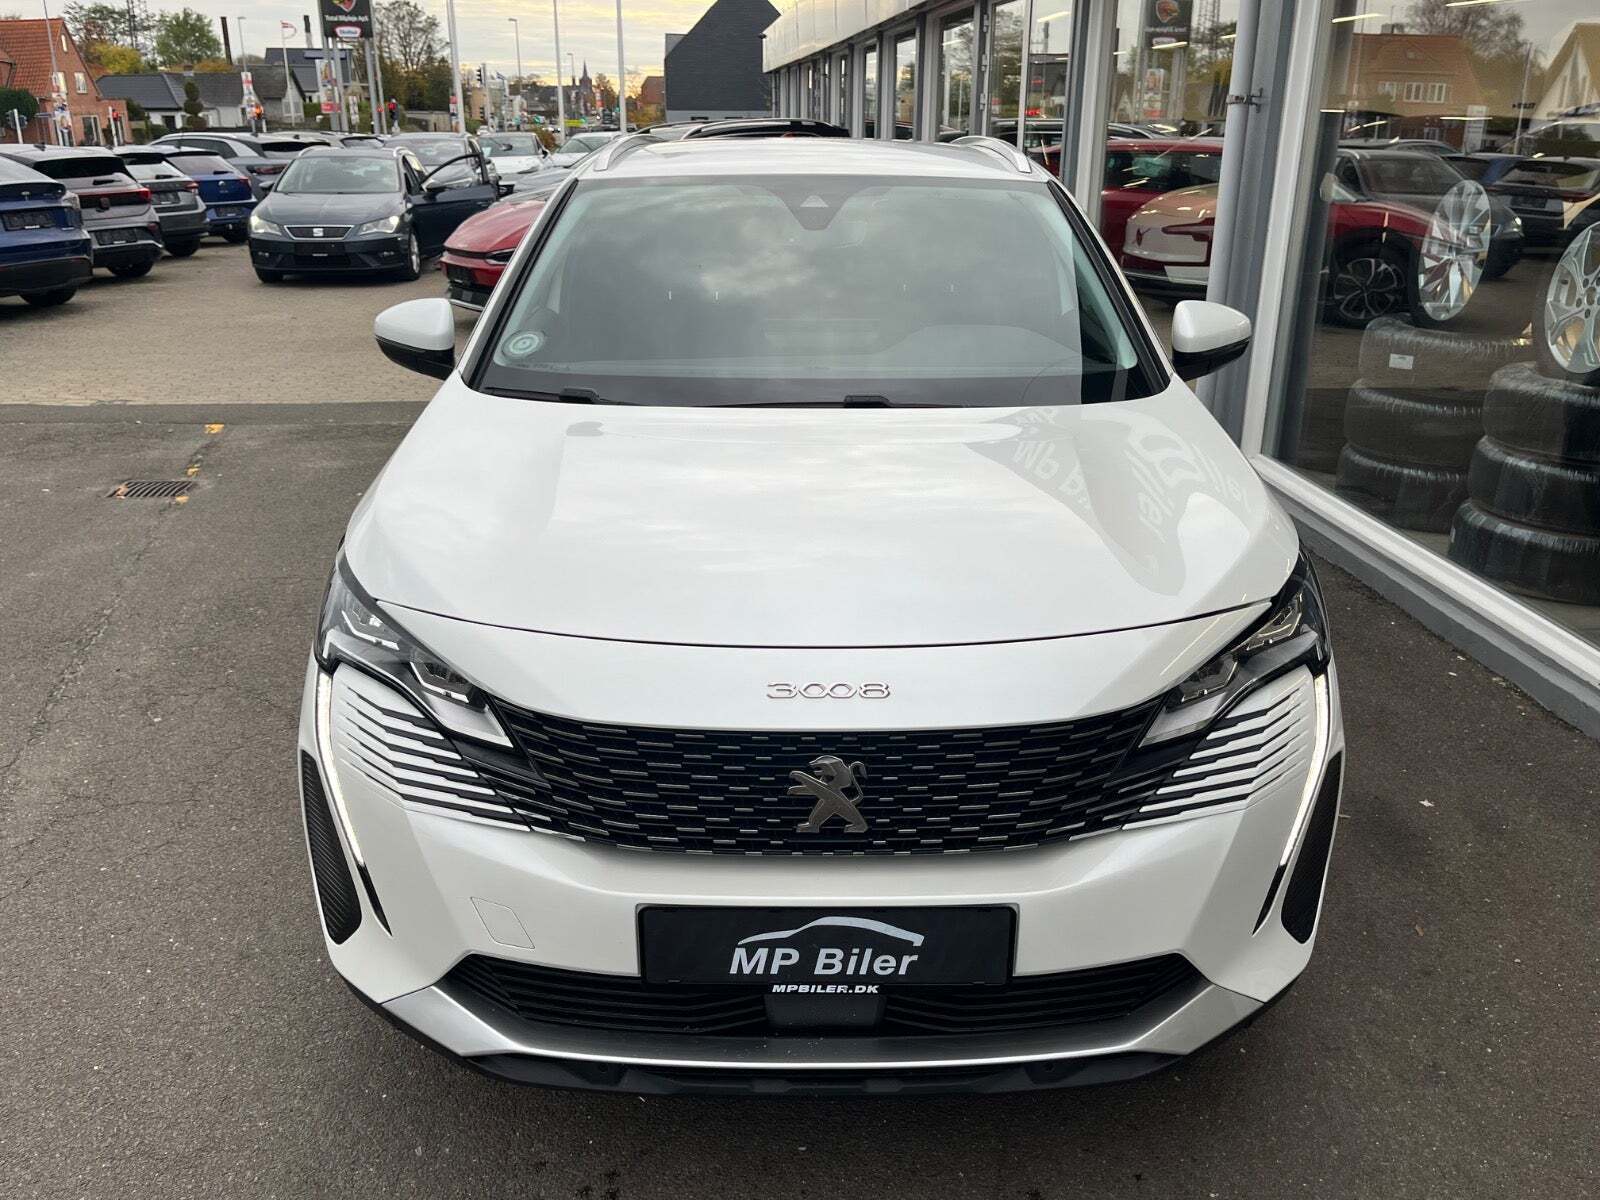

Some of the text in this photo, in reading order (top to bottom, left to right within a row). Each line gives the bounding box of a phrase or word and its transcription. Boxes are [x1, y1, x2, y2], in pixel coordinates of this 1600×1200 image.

[767, 681, 891, 699] 3008
[729, 947, 919, 976] MP Biler
[771, 983, 880, 994] MPBILER.DK
